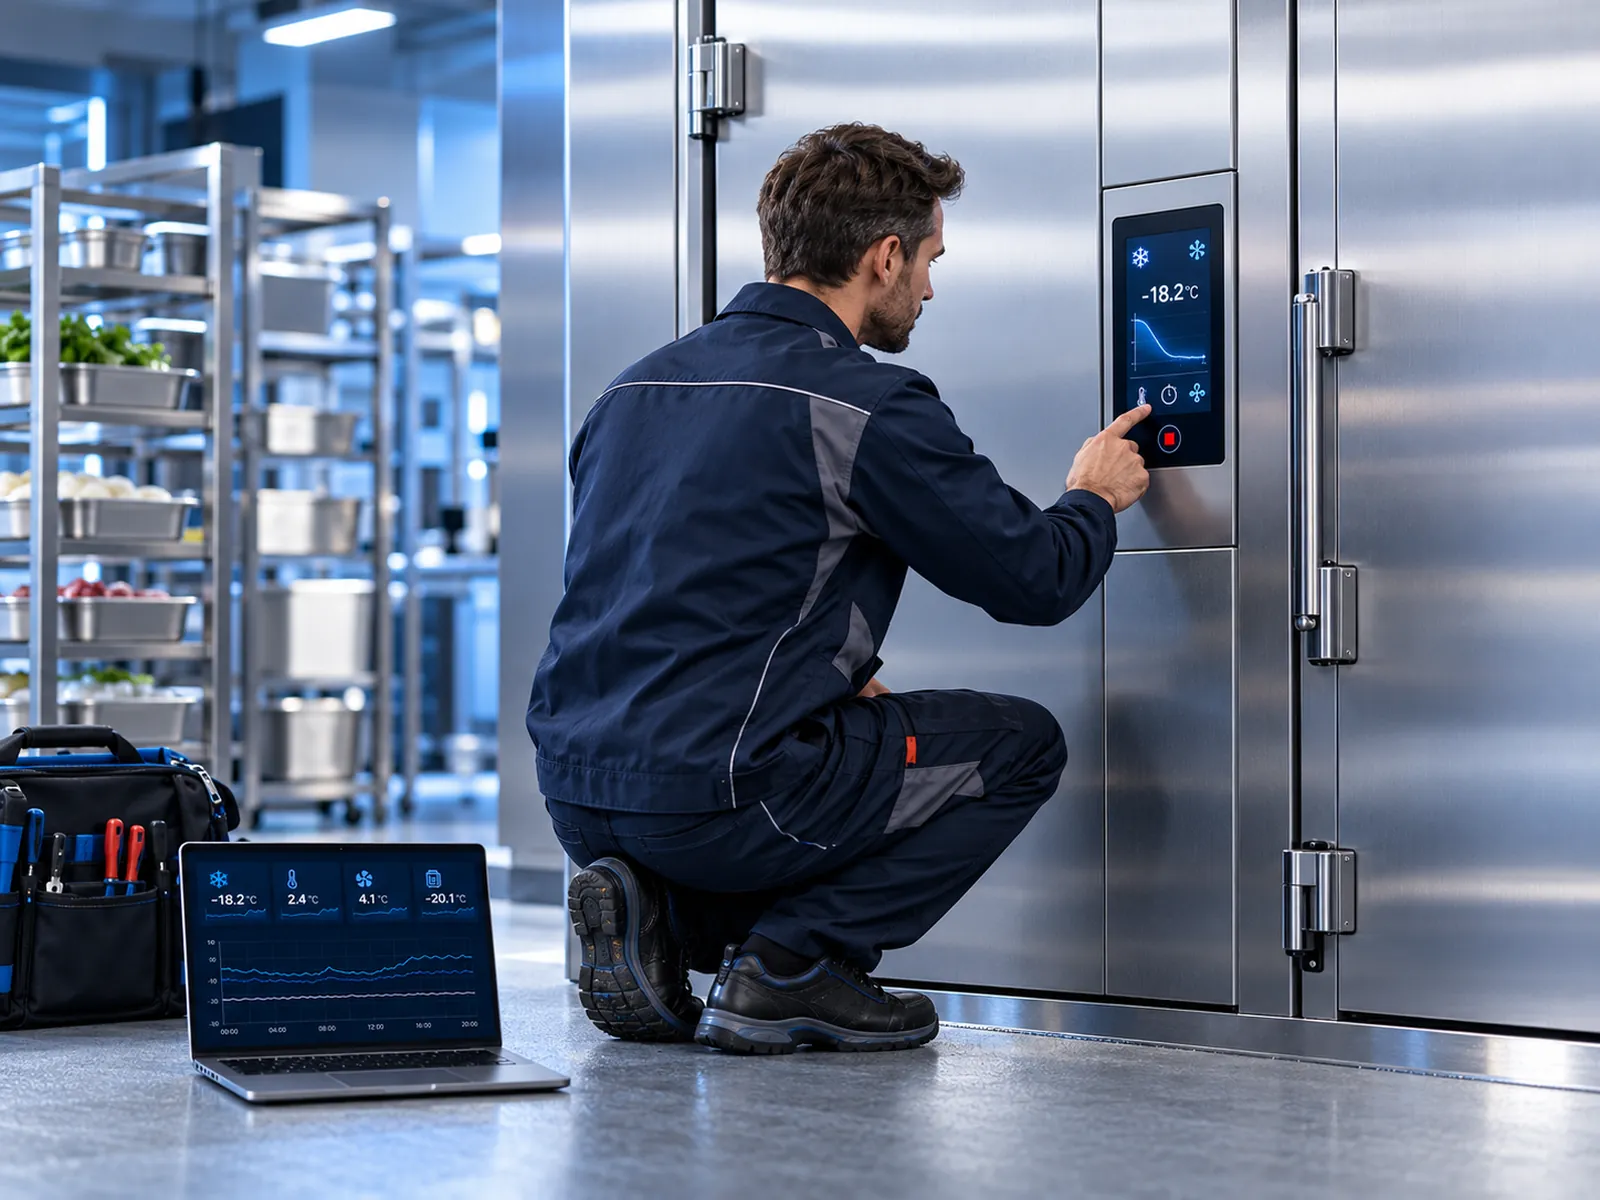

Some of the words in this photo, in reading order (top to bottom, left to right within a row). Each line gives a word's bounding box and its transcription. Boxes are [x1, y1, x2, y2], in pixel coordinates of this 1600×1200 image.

[1141, 282, 1199, 304] -18.2°C
[210, 893, 257, 906] -18.2°C
[287, 893, 319, 905] 2.4°C
[358, 893, 389, 905] 4.1°C
[425, 892, 467, 904] -20.1°C
[317, 1024, 337, 1032] 0800
[367, 1023, 385, 1031] 1200
[415, 1021, 432, 1029] 1600
[461, 1020, 479, 1028] 2000
[219, 1027, 239, 1036] 0000
[267, 1026, 287, 1034] 0400
